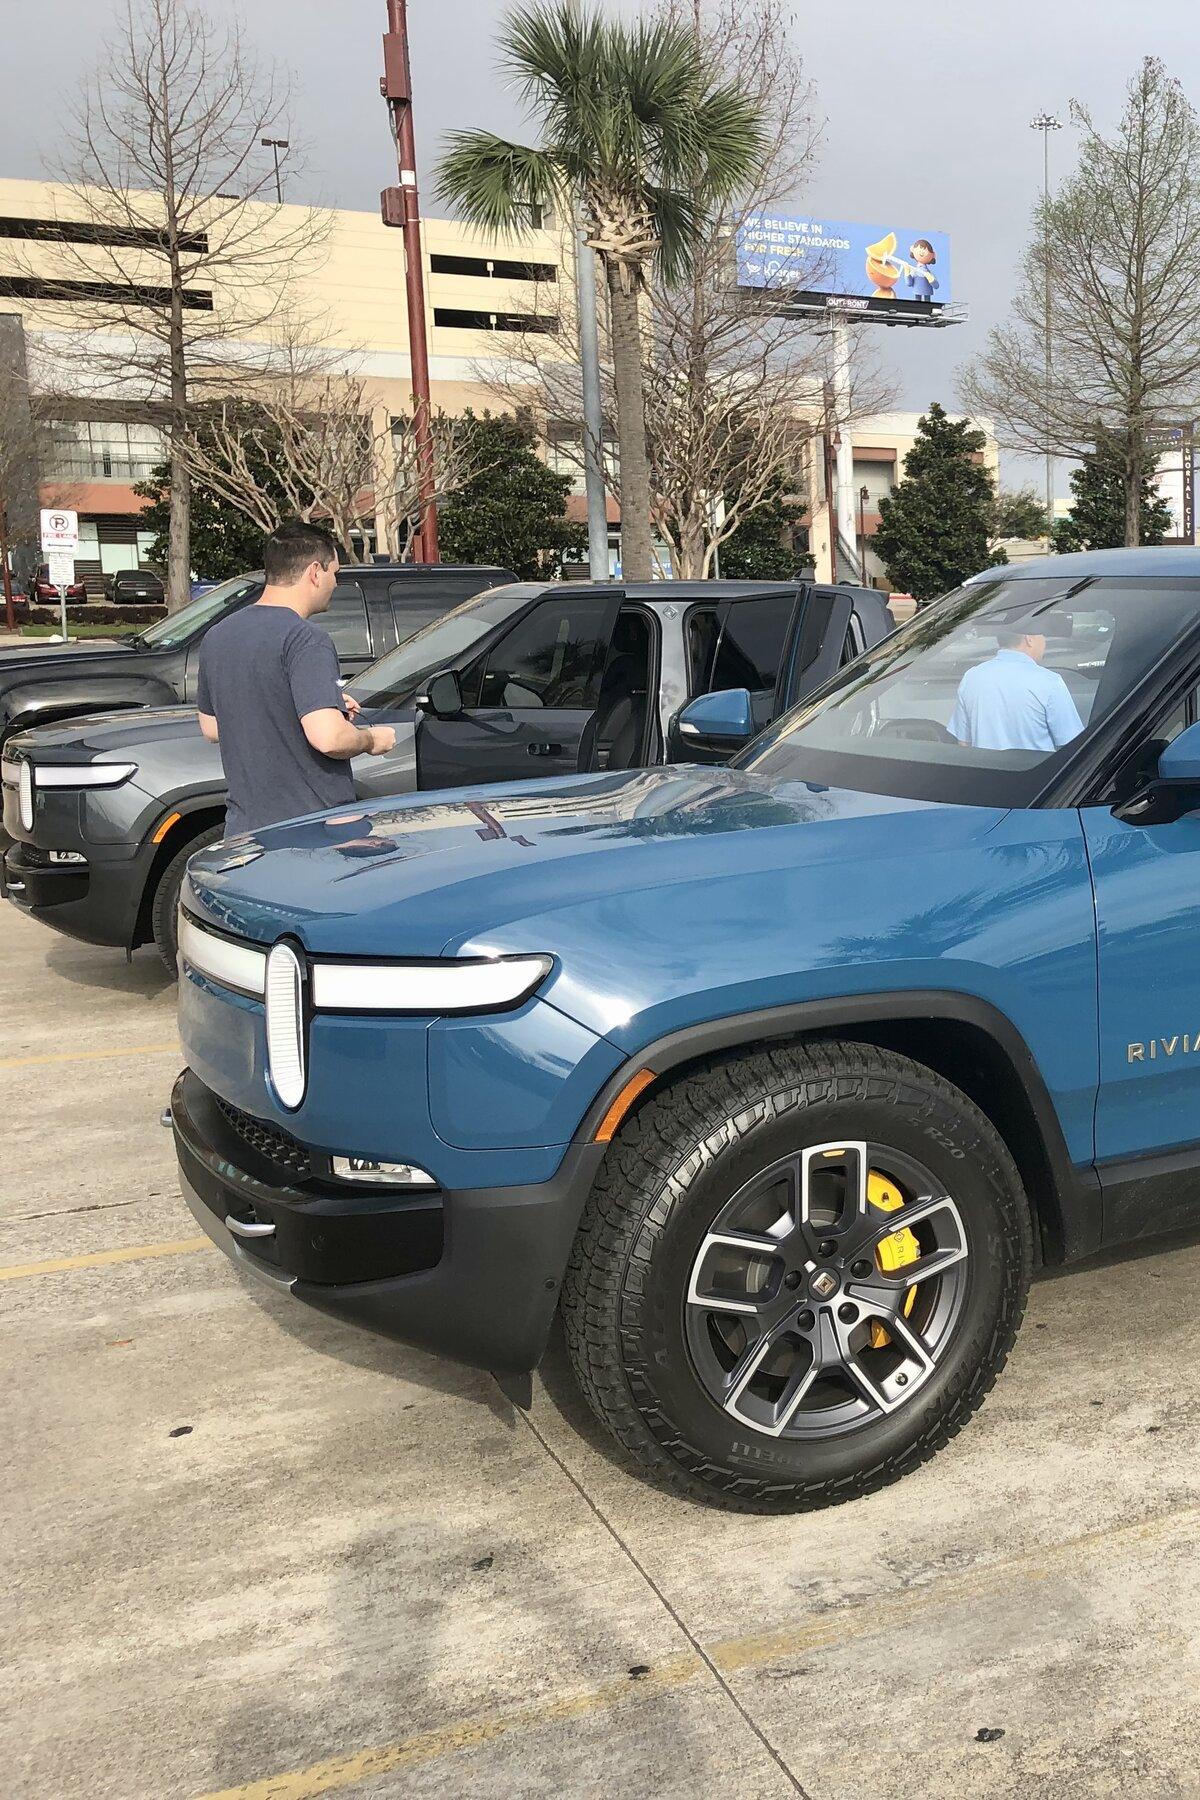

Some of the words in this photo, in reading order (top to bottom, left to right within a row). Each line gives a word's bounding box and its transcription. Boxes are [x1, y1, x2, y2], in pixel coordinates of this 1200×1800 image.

[744, 218, 761, 228] WE
[765, 219, 808, 232] BELIEVE
[811, 224, 822, 235] IN
[744, 229, 785, 242] HIGHER
[788, 234, 850, 250] STANDARDS
[744, 242, 766, 253] FOR
[770, 245, 804, 257] FRESH
